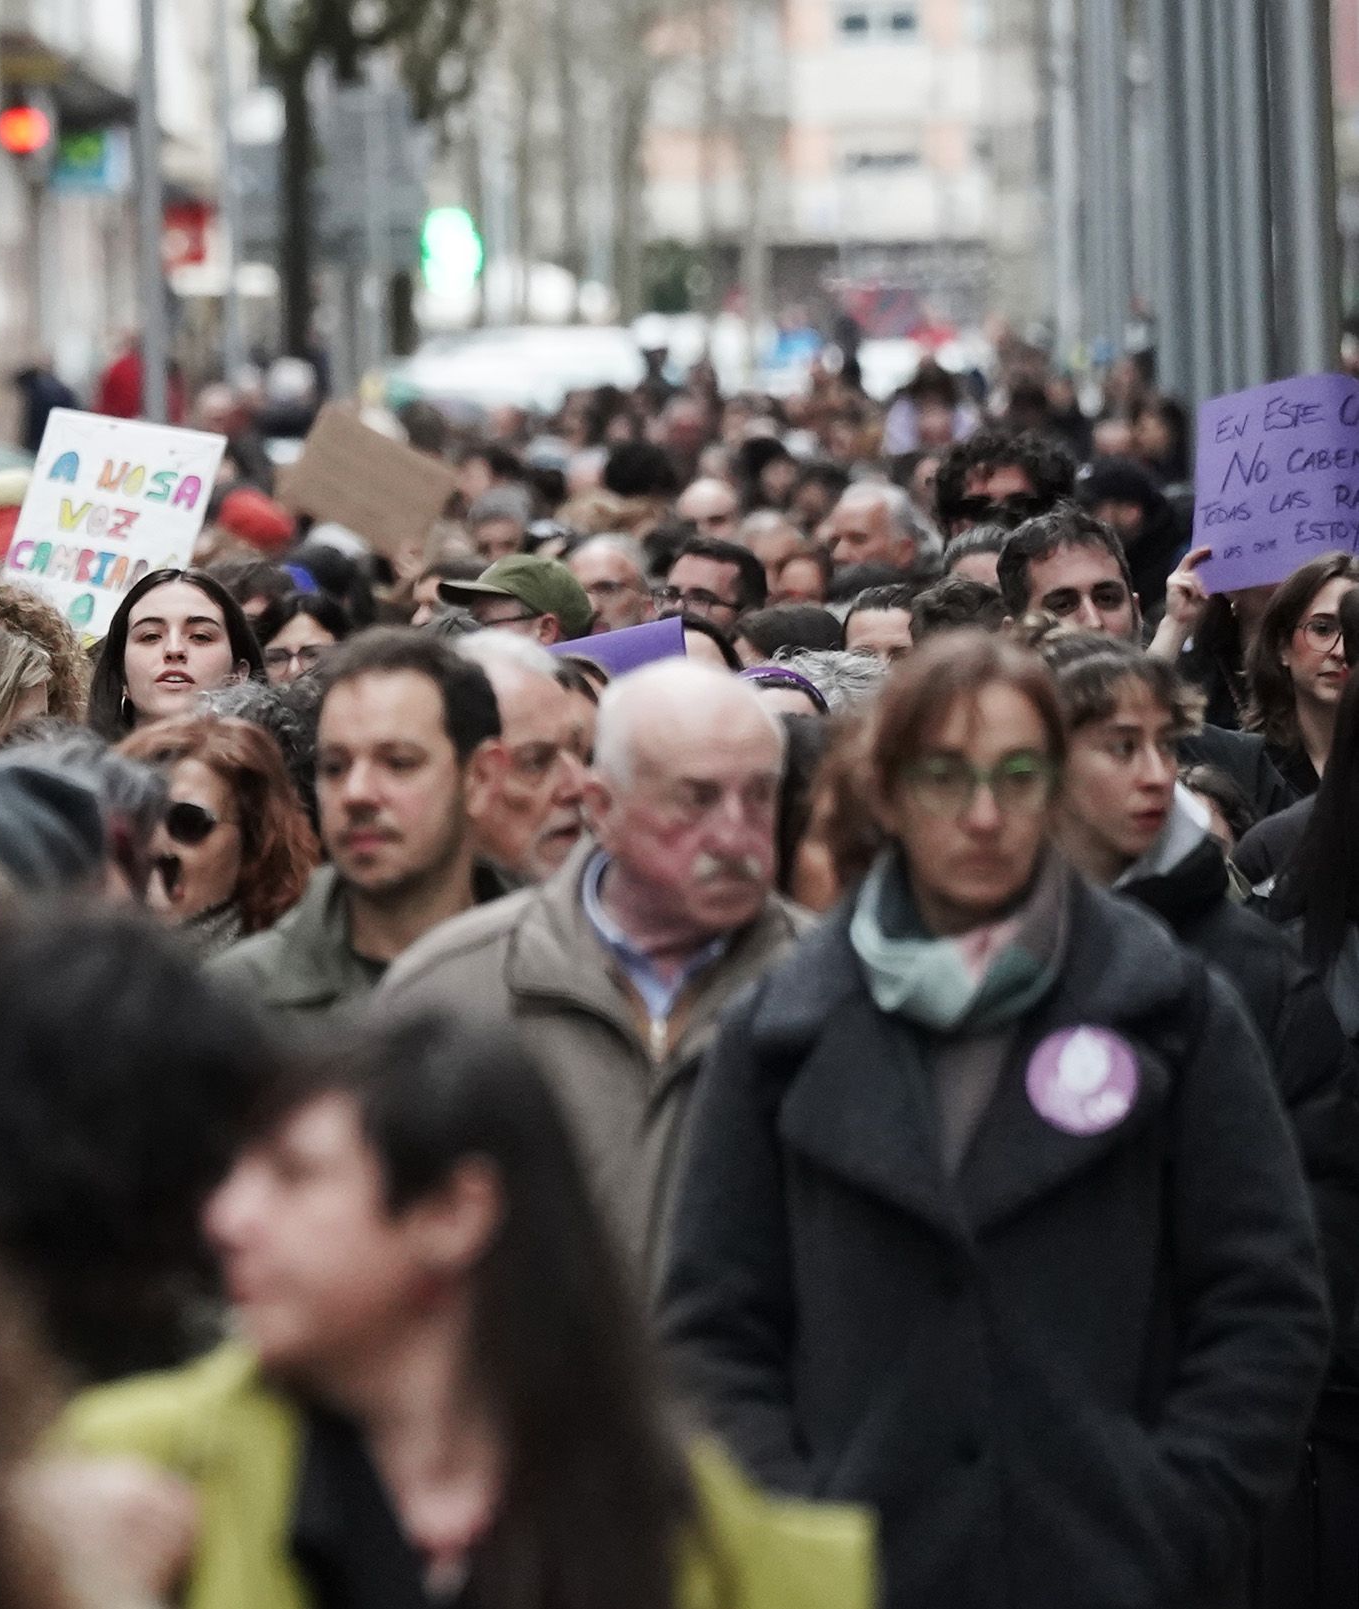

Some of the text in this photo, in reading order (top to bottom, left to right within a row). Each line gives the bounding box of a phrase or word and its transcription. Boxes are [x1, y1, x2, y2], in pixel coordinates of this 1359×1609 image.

[1215, 414, 1249, 444] EN
[1263, 396, 1325, 431] ESTE
[48, 451, 202, 511] A NOSA
[58, 498, 139, 540] VOZ
[1200, 501, 1251, 527] TODAS
[1269, 490, 1310, 514] LAS
